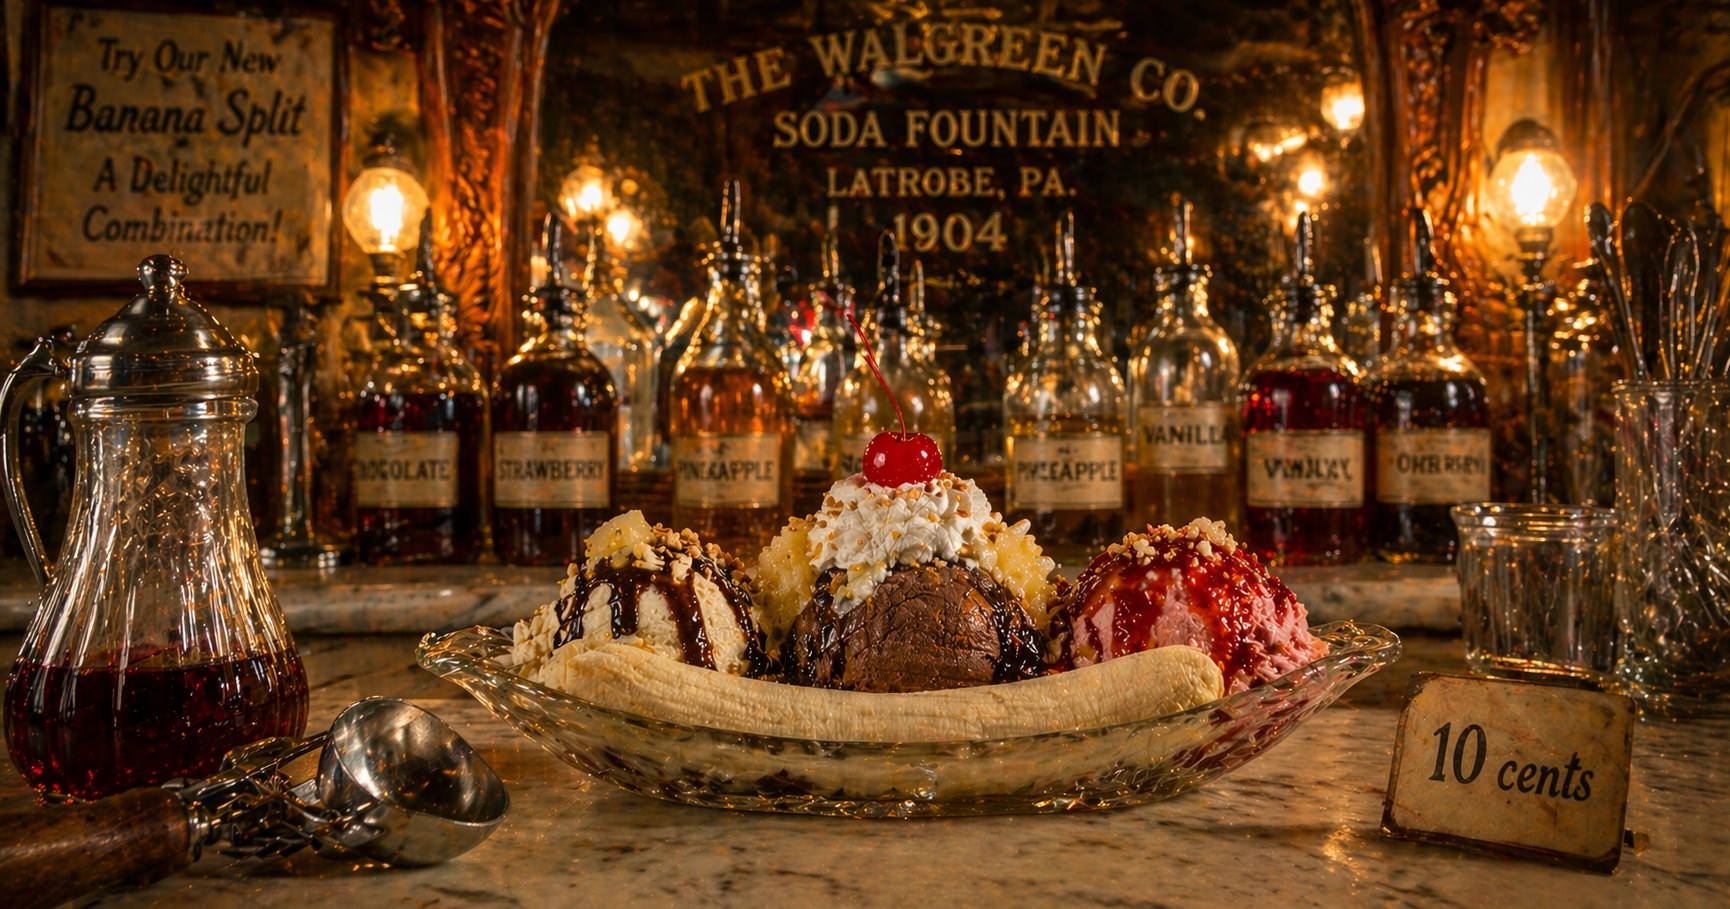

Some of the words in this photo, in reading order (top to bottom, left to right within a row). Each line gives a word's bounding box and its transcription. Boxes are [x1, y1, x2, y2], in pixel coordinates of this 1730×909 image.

[97, 37, 143, 81] Try
[155, 39, 209, 73] Our
[219, 41, 282, 75] New
[681, 47, 792, 113] THE
[809, 22, 1107, 85] WALGREEN
[1129, 57, 1206, 121] CO.
[65, 83, 205, 134] Banana
[218, 88, 306, 147] Split
[773, 109, 887, 149] SODA
[905, 109, 1120, 148] FOUNTAIN
[93, 157, 117, 193] A
[130, 155, 273, 206] Delightful
[826, 166, 1006, 201] LATROBE,
[1019, 166, 1078, 198] PA.
[83, 204, 283, 244] Combination!
[893, 211, 1008, 253] 1904
[498, 459, 605, 481] STRAWBERRY
[1429, 722, 1487, 784] 10
[1498, 752, 1594, 801] cents
